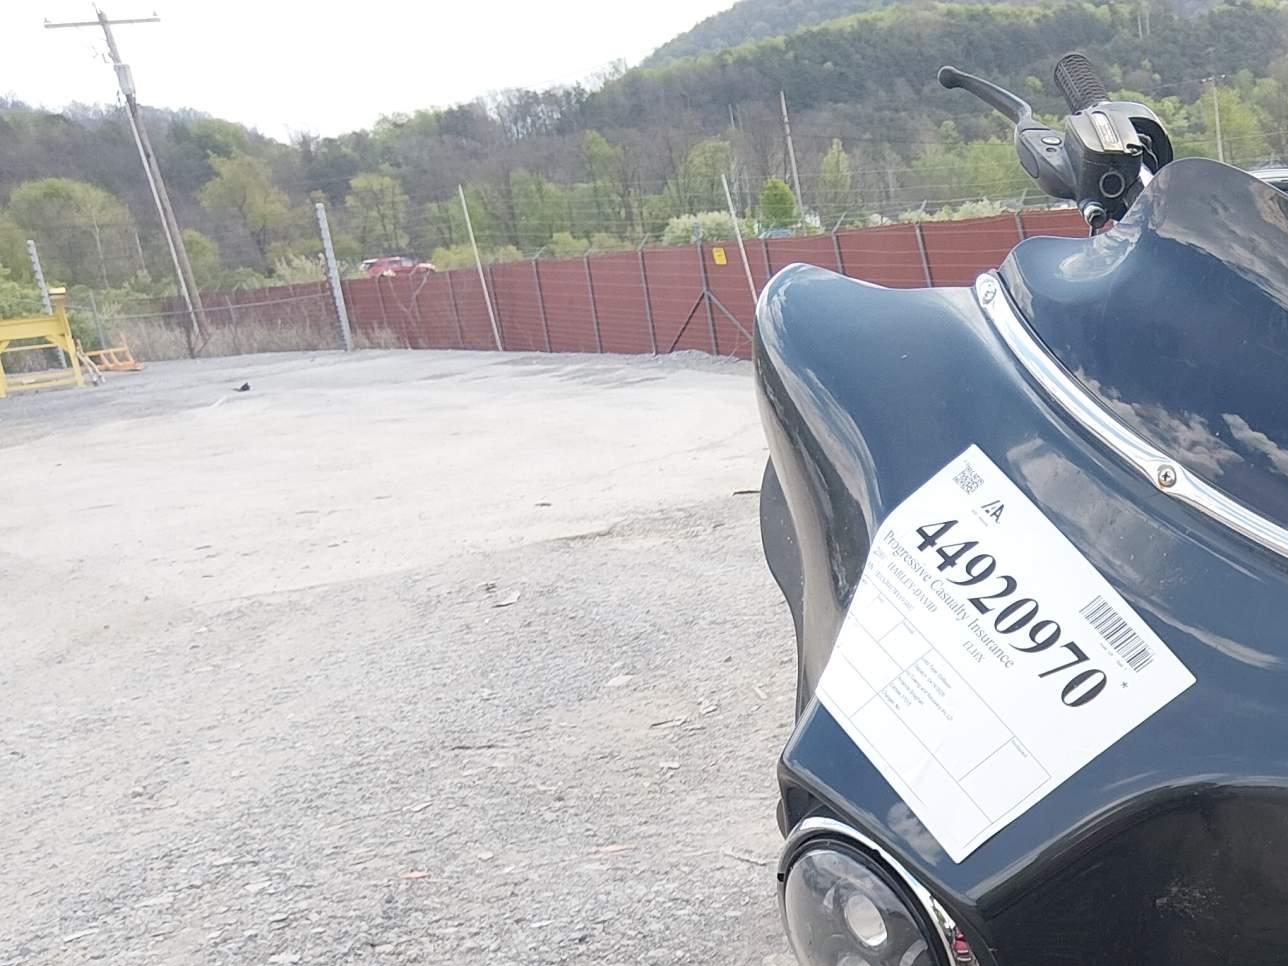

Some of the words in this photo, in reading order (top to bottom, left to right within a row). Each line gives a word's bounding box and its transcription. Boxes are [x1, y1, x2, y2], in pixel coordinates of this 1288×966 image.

[884, 529, 932, 582] Progressive
[930, 578, 970, 621] Casualty
[967, 618, 1015, 669] Insurance
[916, 519, 1108, 708] 44920970
